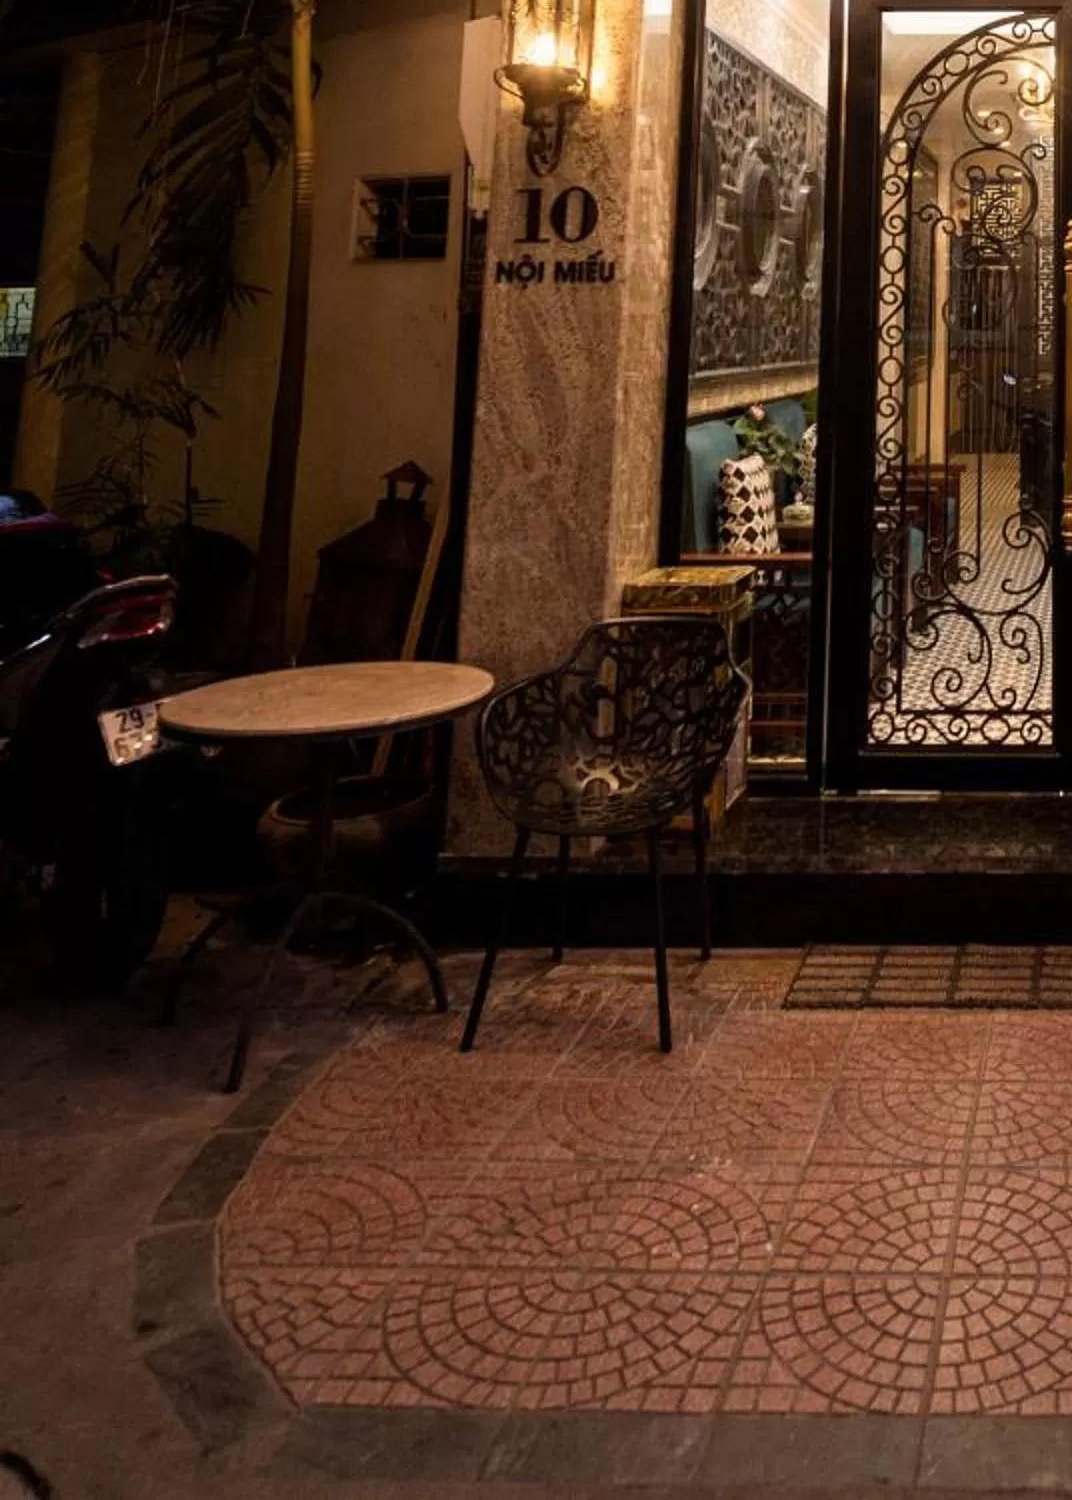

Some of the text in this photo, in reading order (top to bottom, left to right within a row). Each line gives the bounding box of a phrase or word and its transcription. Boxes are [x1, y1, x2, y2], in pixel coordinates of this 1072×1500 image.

[513, 186, 599, 243] 10
[496, 250, 616, 289] NỘI MIẾU
